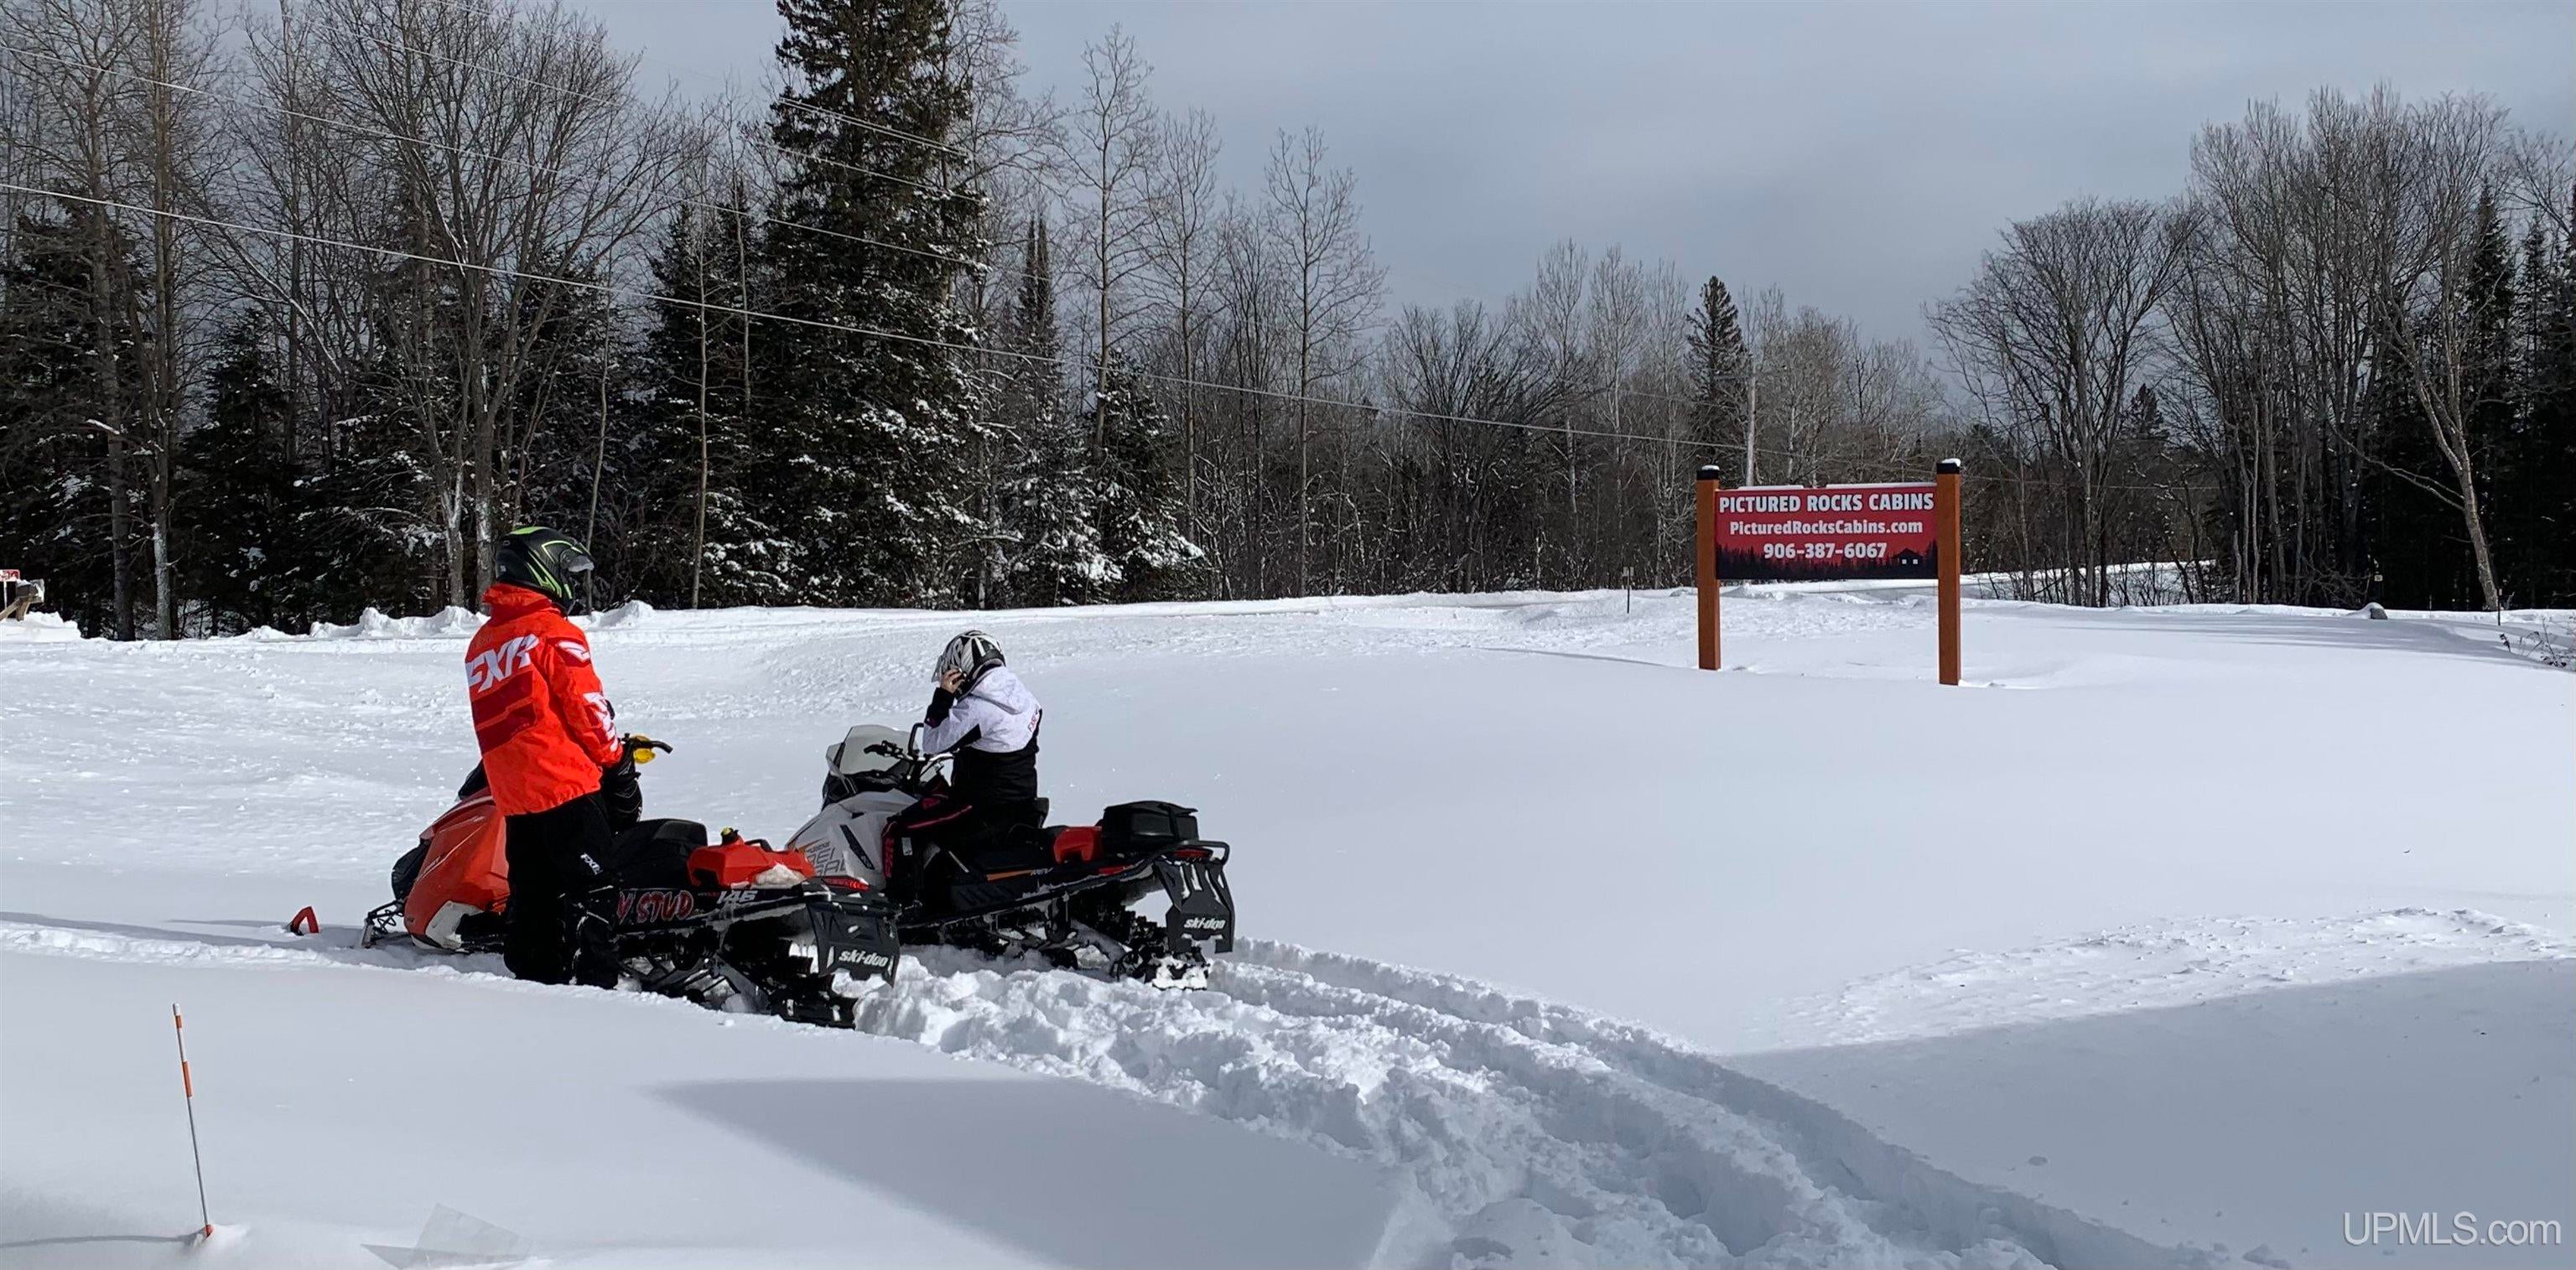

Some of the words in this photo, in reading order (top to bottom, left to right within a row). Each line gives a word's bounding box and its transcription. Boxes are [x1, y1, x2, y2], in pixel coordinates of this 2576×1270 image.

[1719, 496, 1801, 513] PICTURED
[1807, 495, 1862, 512] ROCKS
[1868, 493, 1935, 511] CABINS
[1730, 520, 1923, 535] PicturedRocksCabins.com
[1763, 542, 1888, 558] 906-387-6067
[465, 634, 540, 693] FXR
[636, 890, 693, 923] STUD
[1182, 917, 1226, 930] ski-doo
[839, 949, 889, 967] ski-doo
